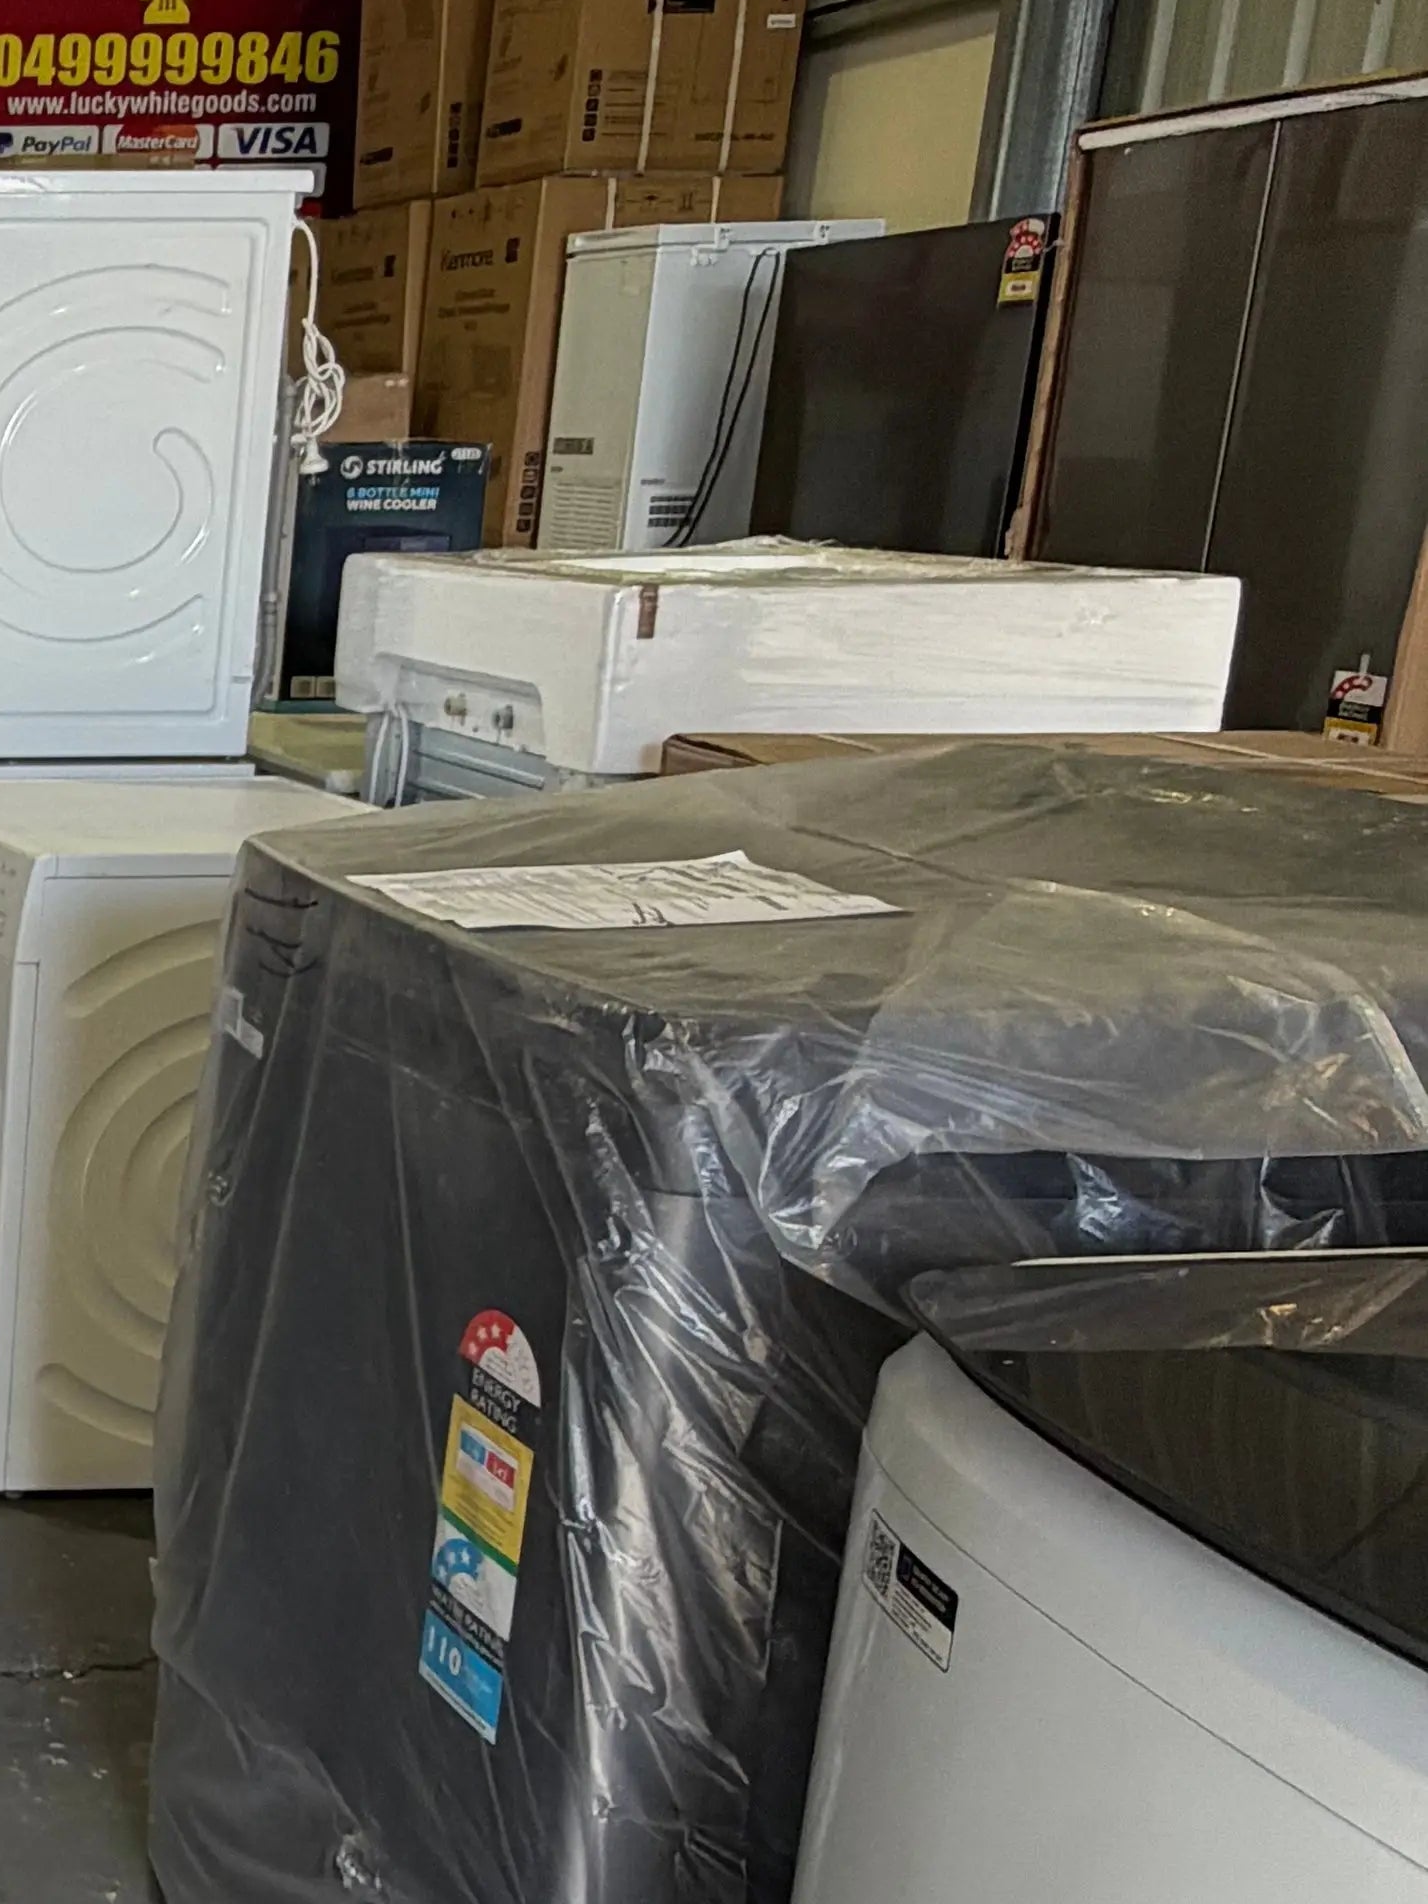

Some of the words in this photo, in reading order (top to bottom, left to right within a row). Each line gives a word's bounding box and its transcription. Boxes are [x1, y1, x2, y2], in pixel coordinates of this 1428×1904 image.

[6, 89, 317, 119] www.luckywhitegoods.com
[21, 135, 92, 155] PayPal
[116, 133, 199, 150] MasterCard
[233, 126, 318, 155] VISA
[366, 459, 443, 475] STIRLING
[357, 486, 408, 498] BOTTLE
[410, 487, 441, 499] MINI
[347, 499, 381, 511] WINE
[383, 498, 437, 510] COOLER
